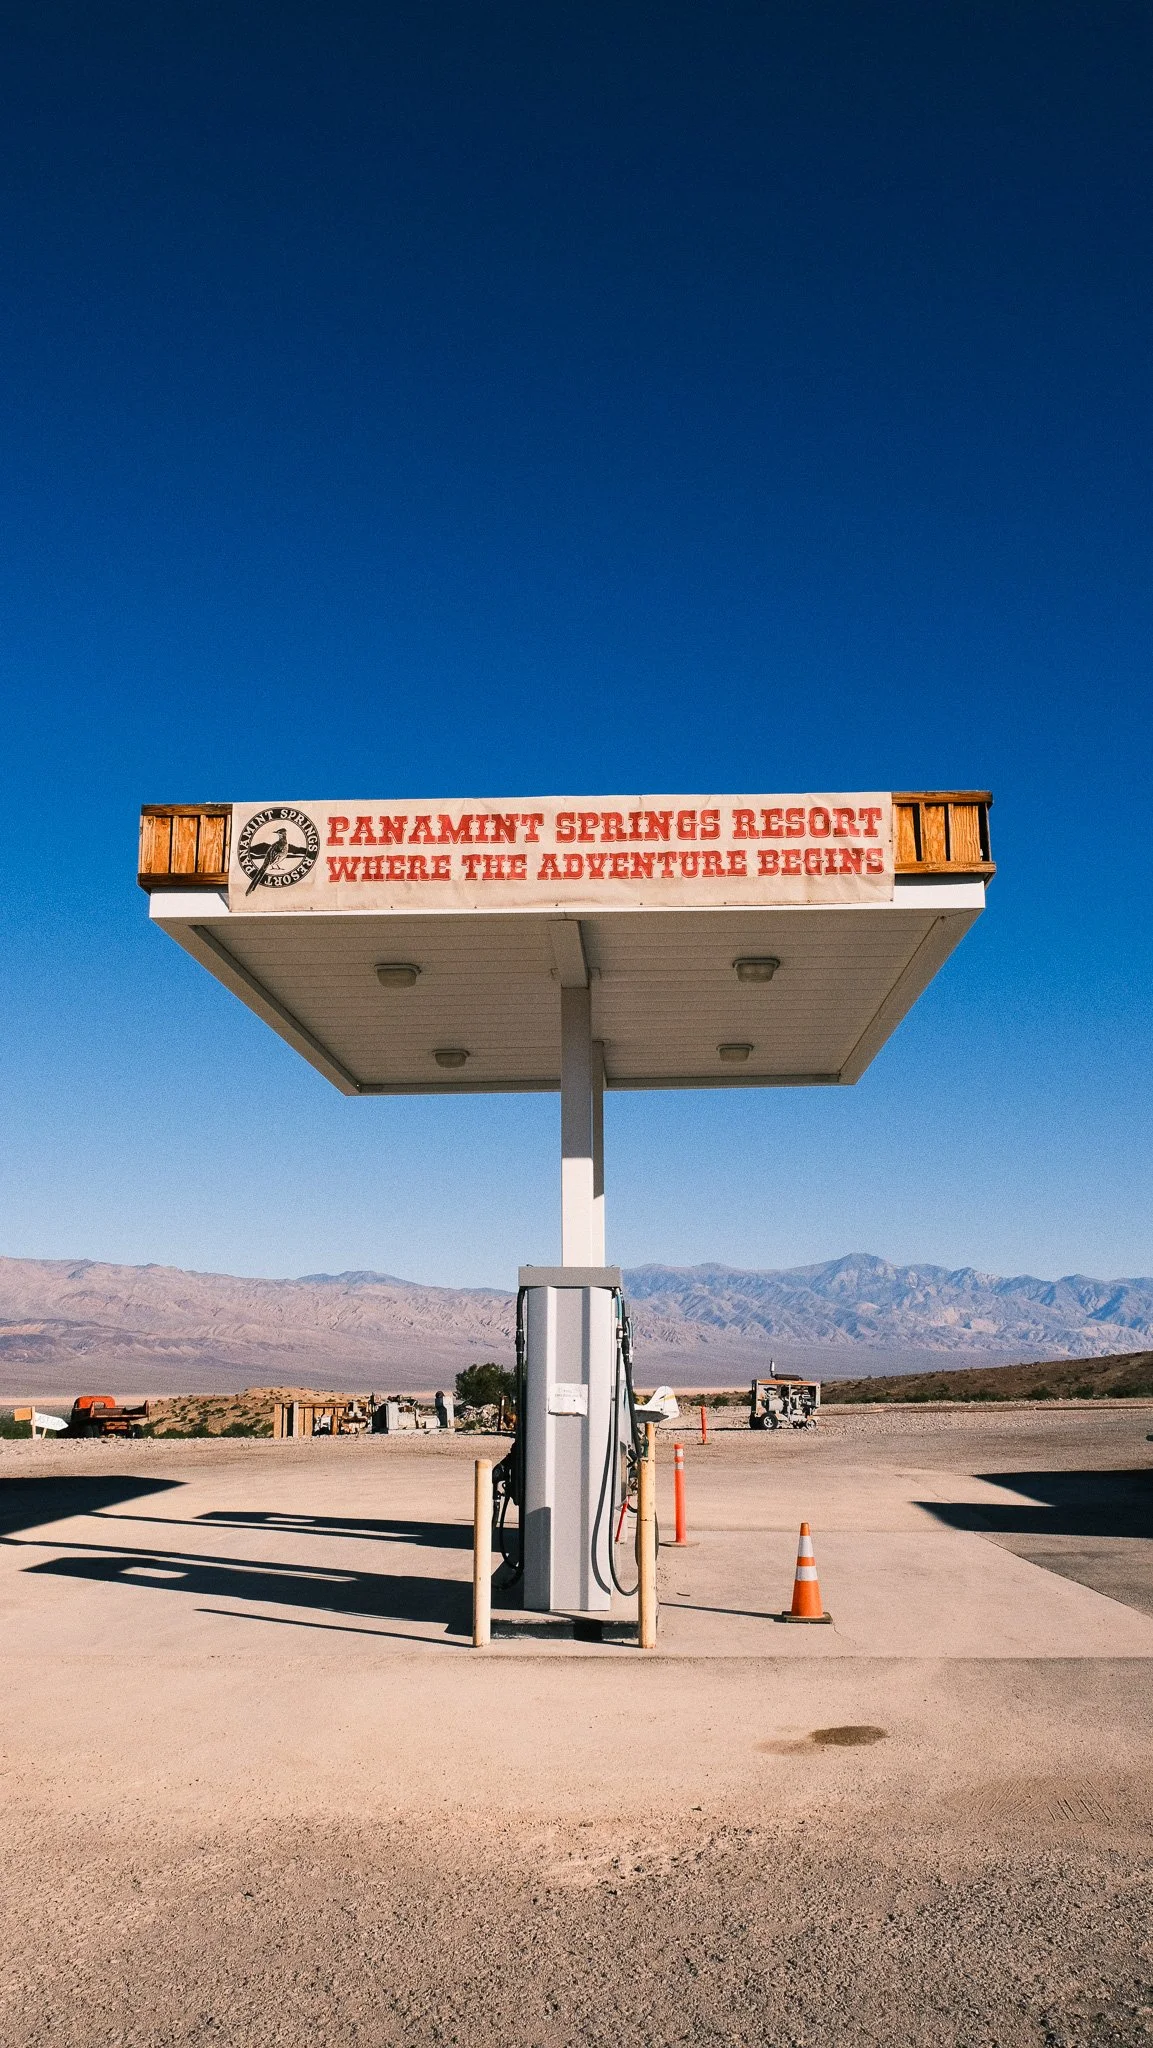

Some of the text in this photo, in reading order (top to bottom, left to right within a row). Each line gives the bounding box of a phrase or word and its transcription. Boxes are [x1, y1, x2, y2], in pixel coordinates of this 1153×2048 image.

[326, 807, 882, 846] PANAMINT SPRINGS RESORT
[240, 809, 318, 886] PANAMINT SPRINGS RESORT
[326, 847, 885, 882] WHERE THE ADVENTURE BEGINS
